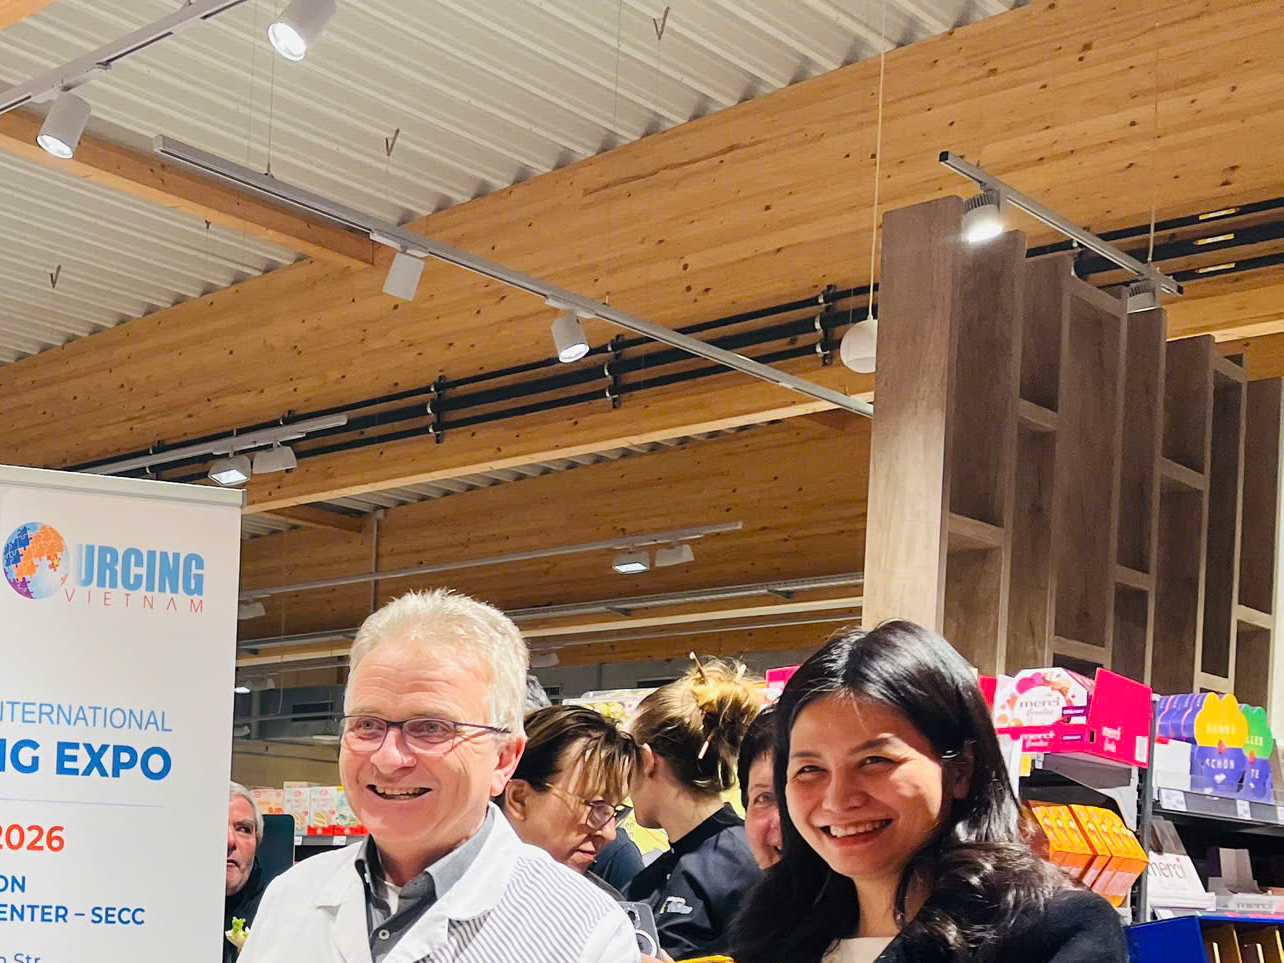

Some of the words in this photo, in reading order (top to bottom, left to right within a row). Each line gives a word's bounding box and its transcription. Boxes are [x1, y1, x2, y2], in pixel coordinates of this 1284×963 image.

[65, 589, 204, 614] VIETNAM
[55, 740, 173, 781] EXPO
[90, 906, 147, 925] SECC
